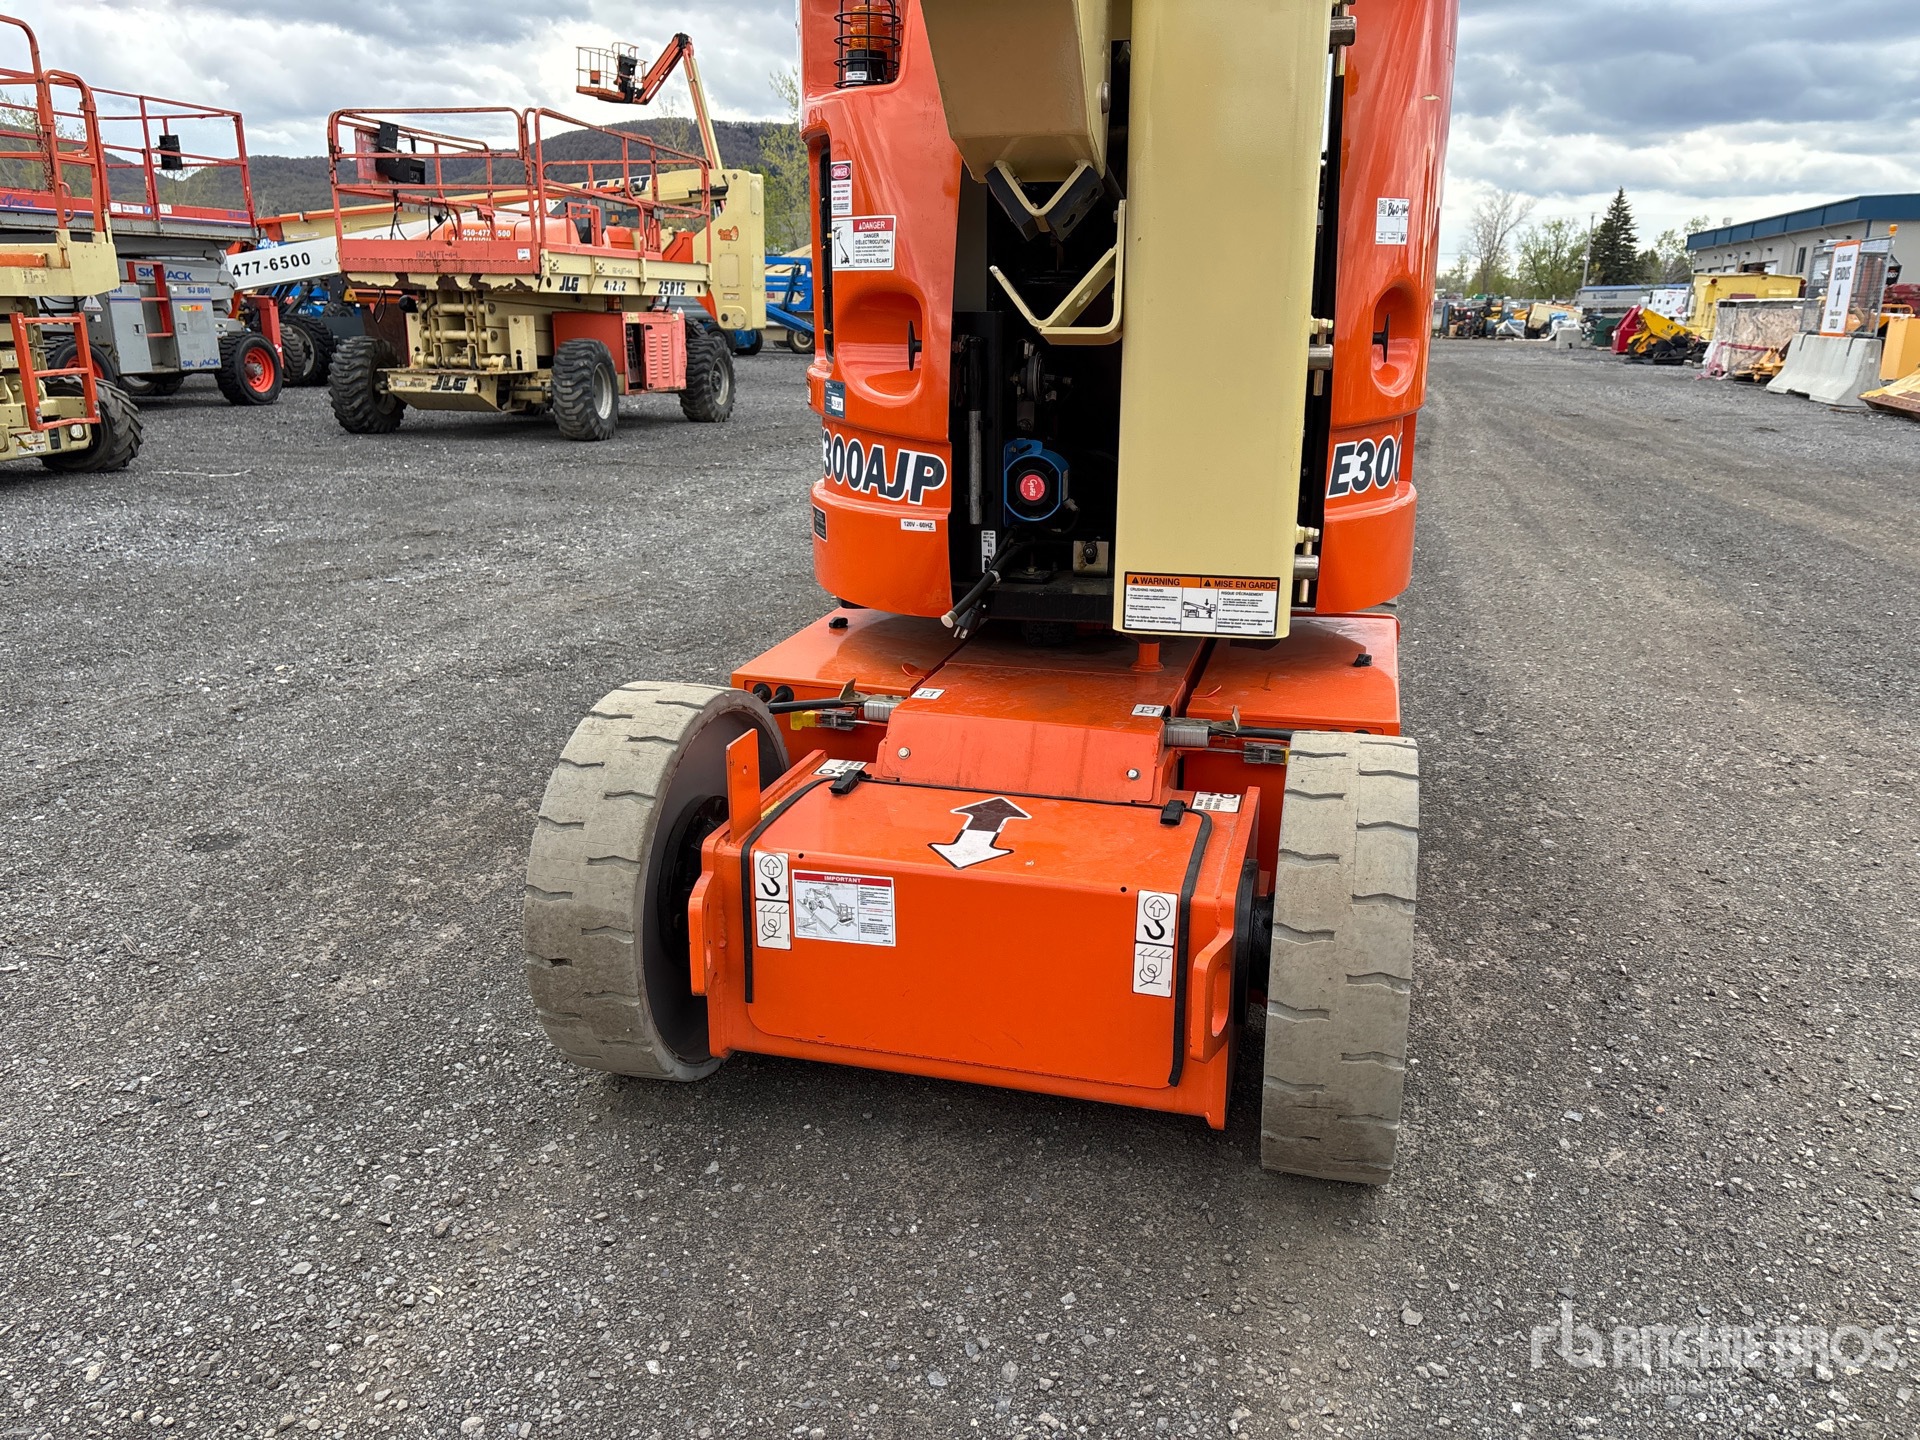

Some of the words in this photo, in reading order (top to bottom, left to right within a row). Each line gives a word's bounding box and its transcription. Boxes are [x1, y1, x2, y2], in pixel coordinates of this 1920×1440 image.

[862, 220, 886, 230] DANGER
[233, 252, 311, 277] 477-6500
[559, 276, 580, 292] JLG
[431, 375, 468, 391] JLG
[1140, 577, 1180, 586] WARNING
[1214, 580, 1233, 588] MISE
[824, 875, 861, 883] IMPORTANT
